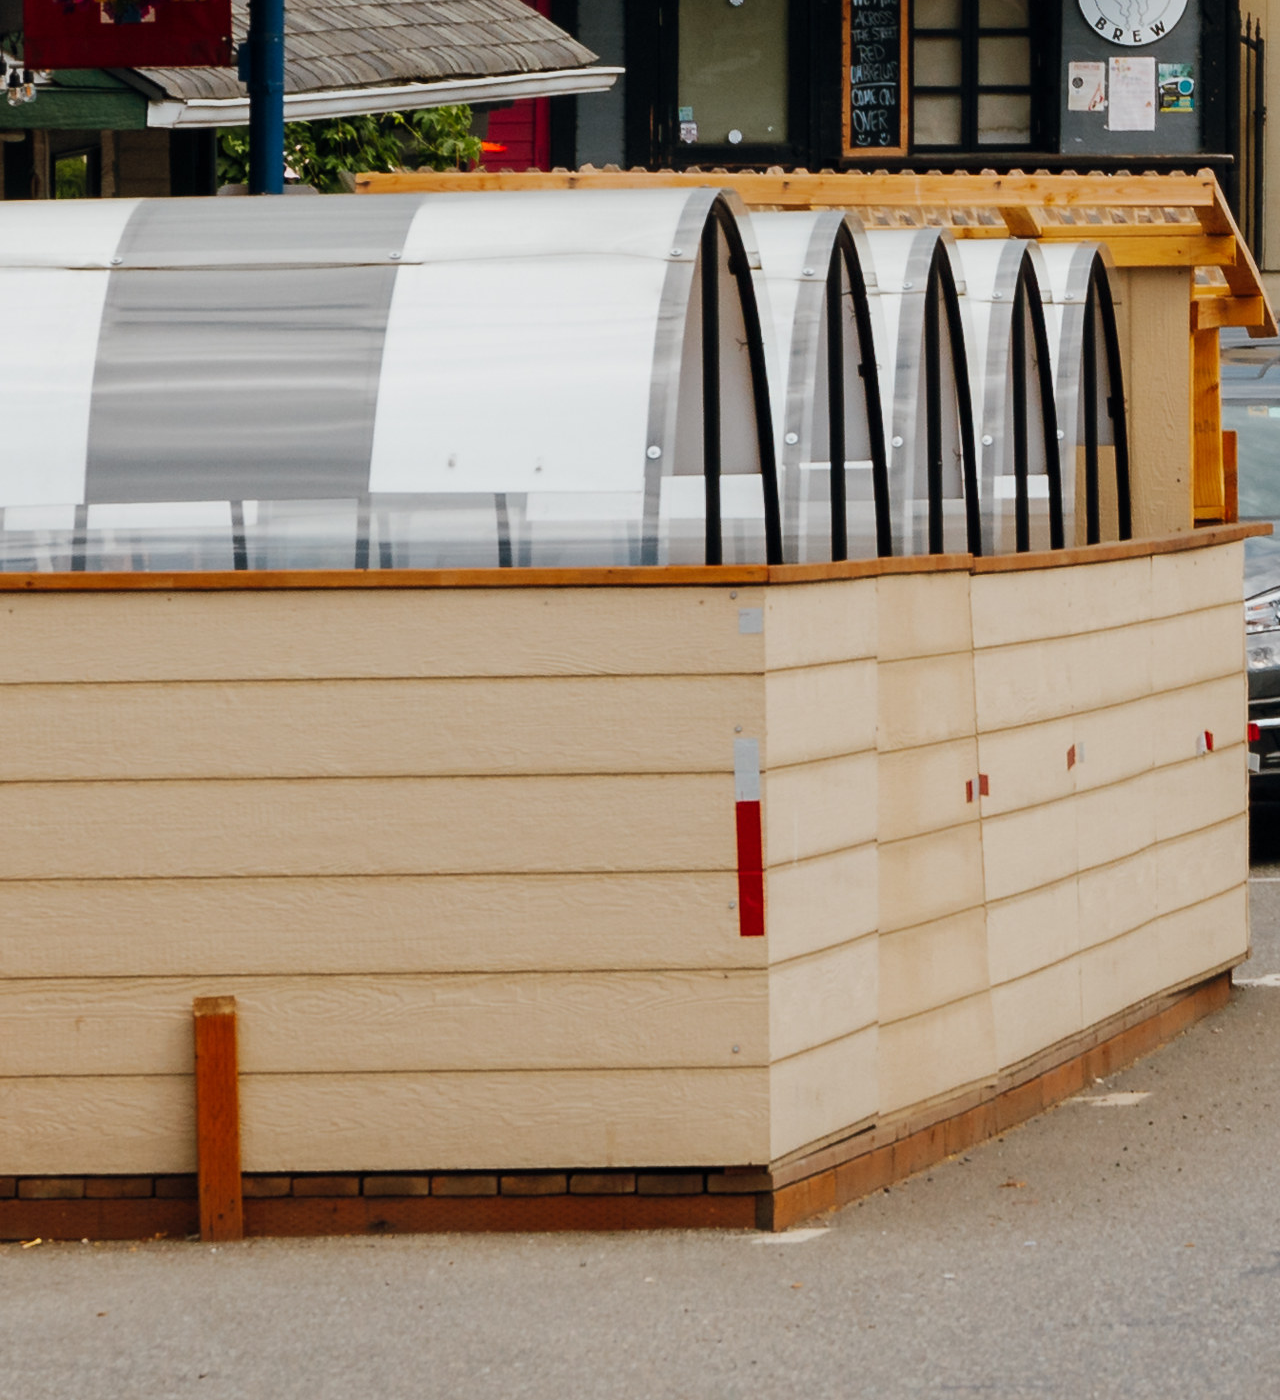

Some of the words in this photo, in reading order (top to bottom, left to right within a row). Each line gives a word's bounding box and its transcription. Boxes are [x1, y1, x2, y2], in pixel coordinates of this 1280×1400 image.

[854, 10, 896, 27] ACROSS
[851, 29, 871, 42] THE
[872, 26, 898, 42] STREET
[1094, 16, 1166, 43] BREW
[857, 43, 886, 64] RED
[851, 88, 877, 107] COME
[878, 88, 896, 107] ON
[852, 109, 888, 133] OVER
